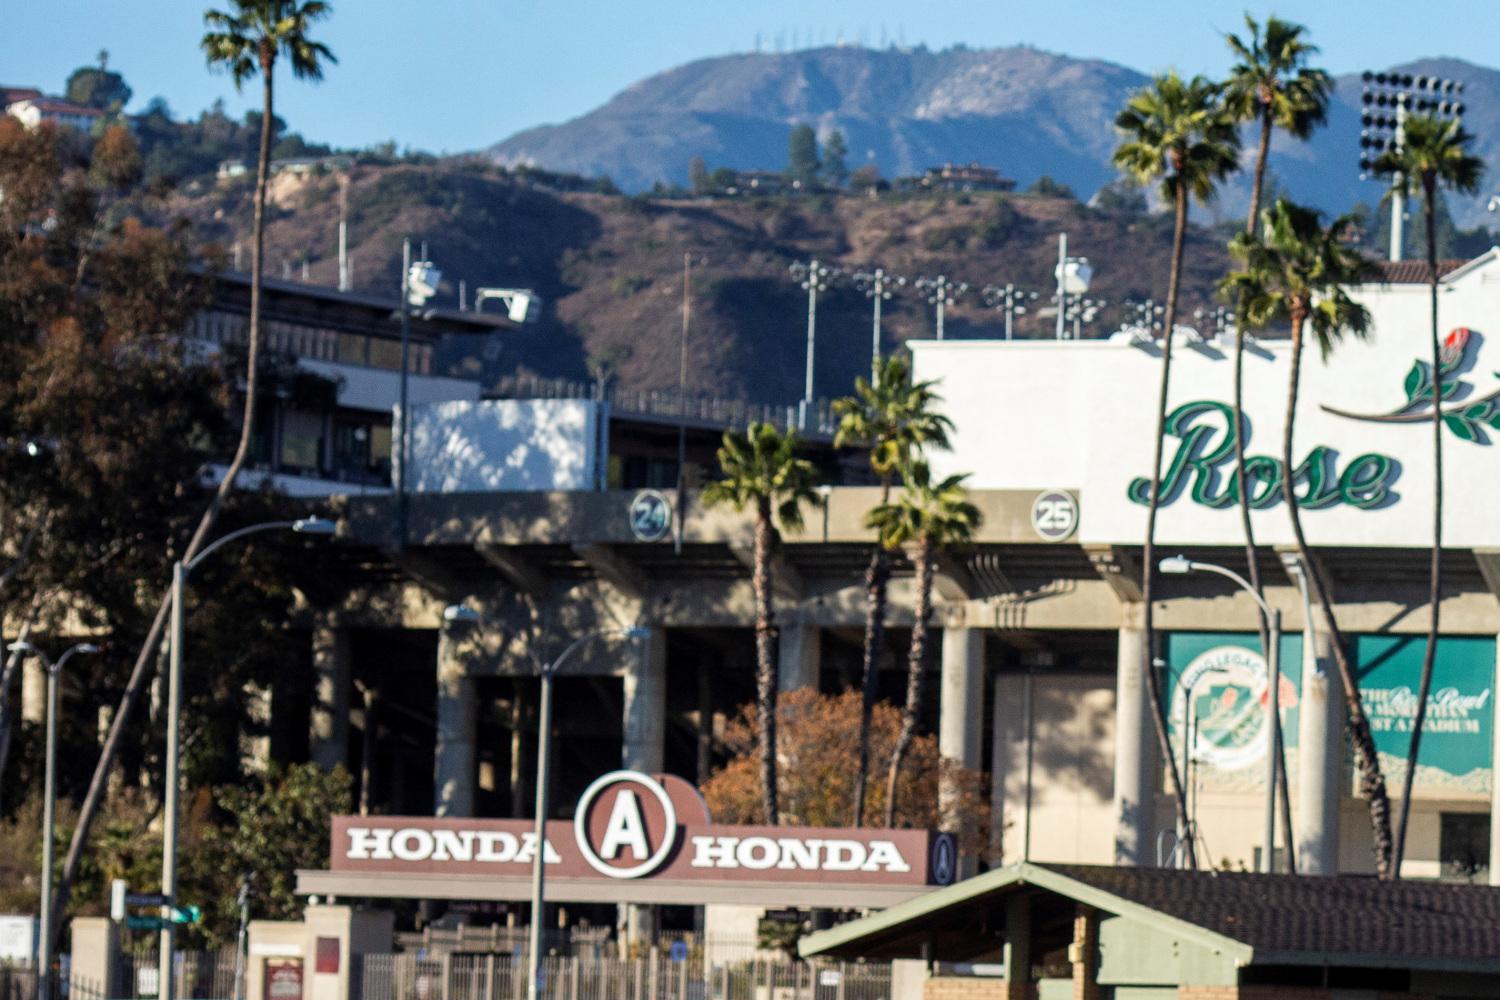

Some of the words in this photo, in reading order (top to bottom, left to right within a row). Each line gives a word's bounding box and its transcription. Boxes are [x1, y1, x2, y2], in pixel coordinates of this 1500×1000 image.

[1128, 400, 1392, 507] Rose
[635, 502, 664, 529] 24
[1037, 500, 1071, 530] 25
[346, 827, 562, 864] HONDA
[691, 835, 910, 873] HONDA
